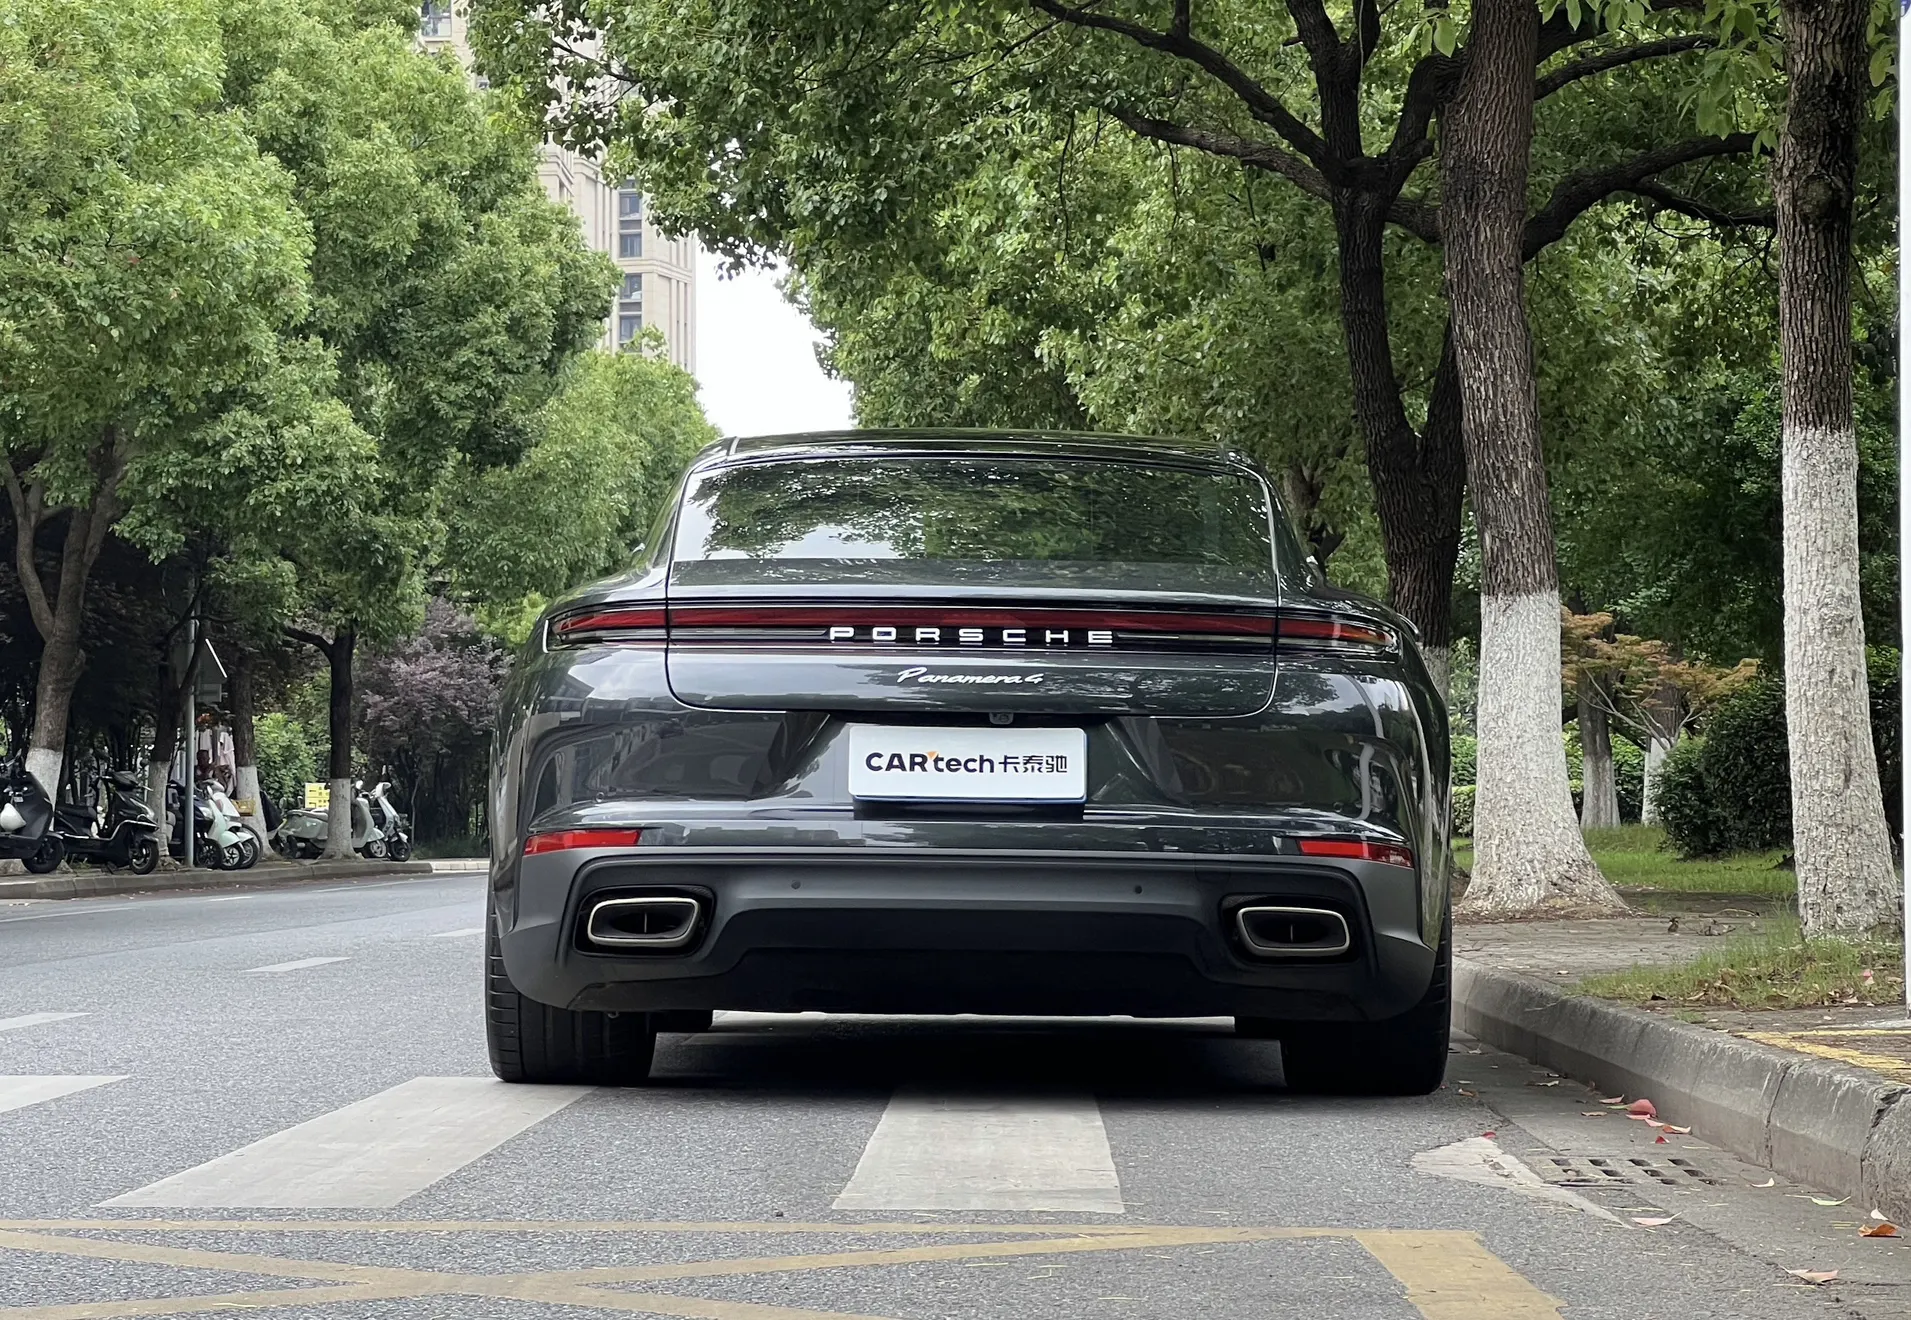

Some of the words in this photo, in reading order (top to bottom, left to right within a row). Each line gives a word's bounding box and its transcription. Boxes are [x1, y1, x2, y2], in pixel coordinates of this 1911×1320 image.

[829, 626, 1113, 644] PORSCHE
[896, 666, 1023, 685] Panamera
[1024, 673, 1044, 685] 4
[998, 754, 1068, 774] 卡泰驰
